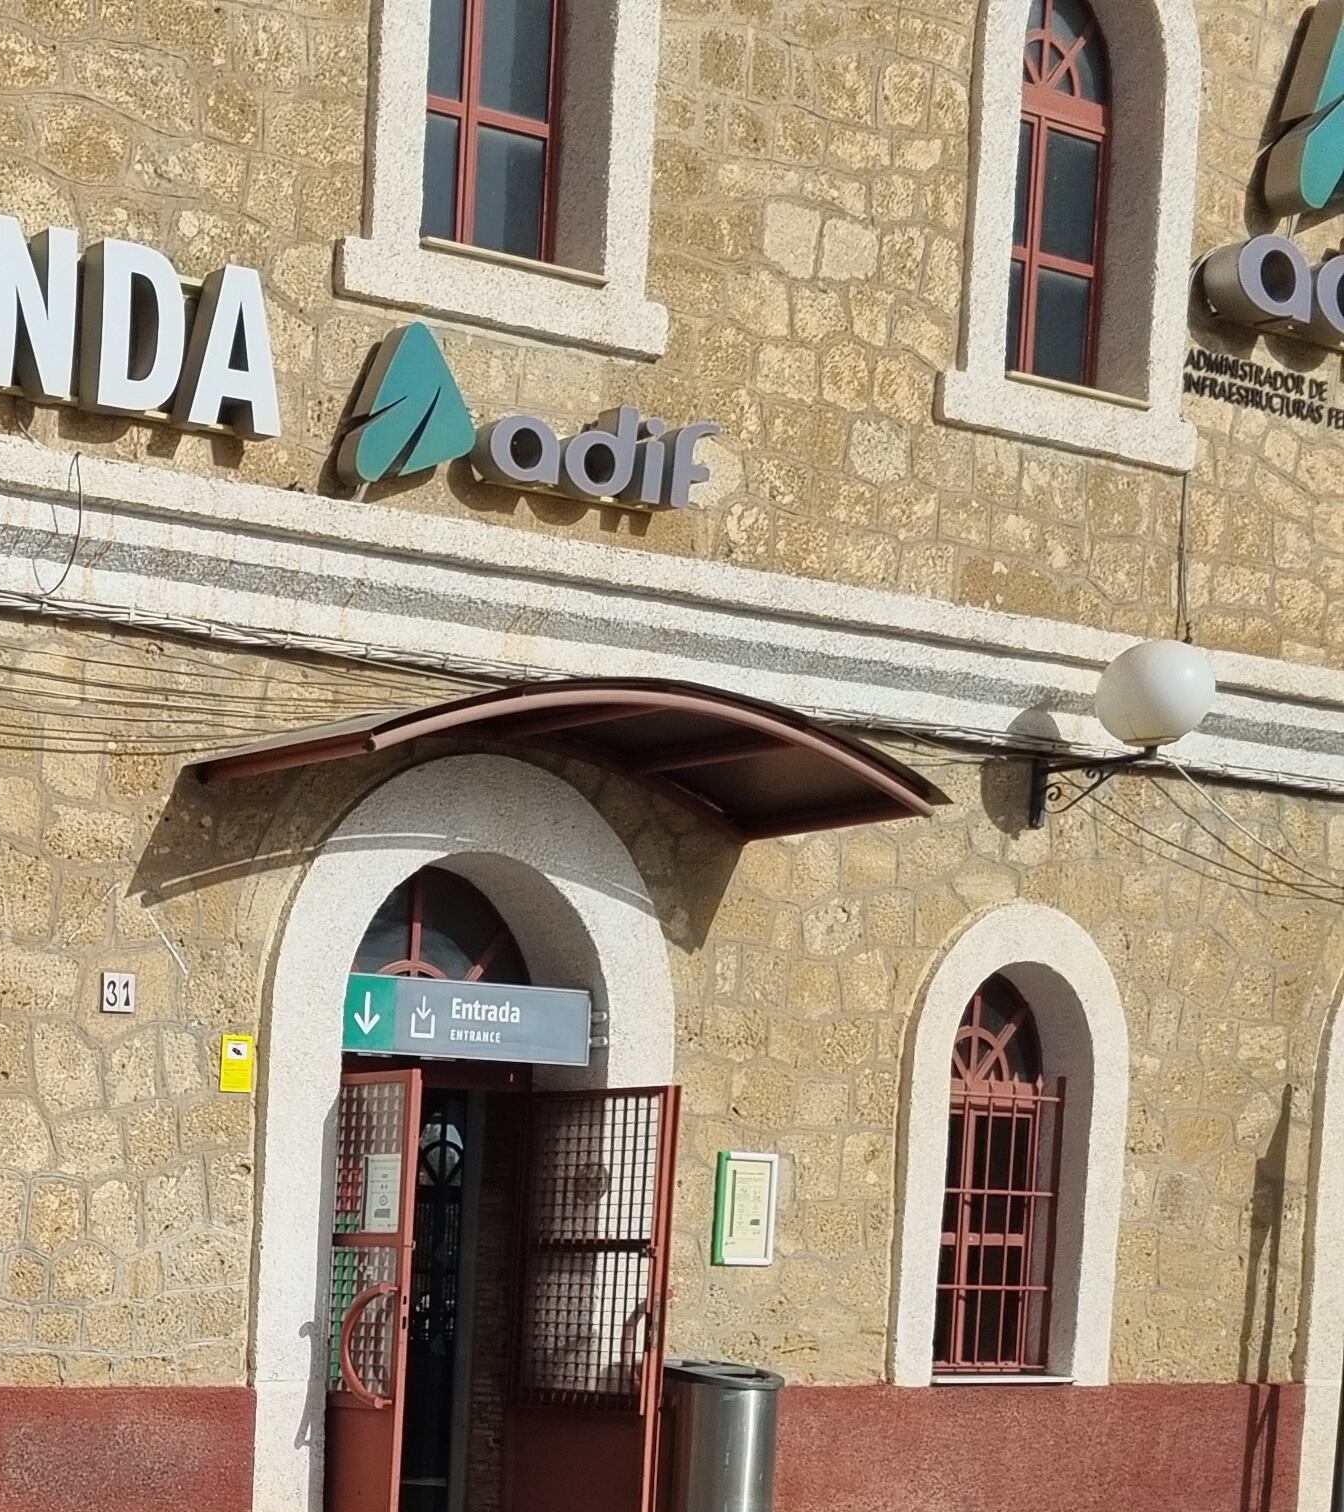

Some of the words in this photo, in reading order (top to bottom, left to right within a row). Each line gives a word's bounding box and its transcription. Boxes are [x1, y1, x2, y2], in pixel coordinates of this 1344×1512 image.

[1184, 349, 1305, 396] ADMINISTRADOR
[1308, 378, 1328, 401] DE
[1183, 371, 1324, 425] INFRAESTRUCTURAS
[488, 404, 720, 508] adif
[105, 979, 131, 1007] 31
[451, 997, 521, 1024] Entrada
[450, 1029, 502, 1044] ENTRANCE
